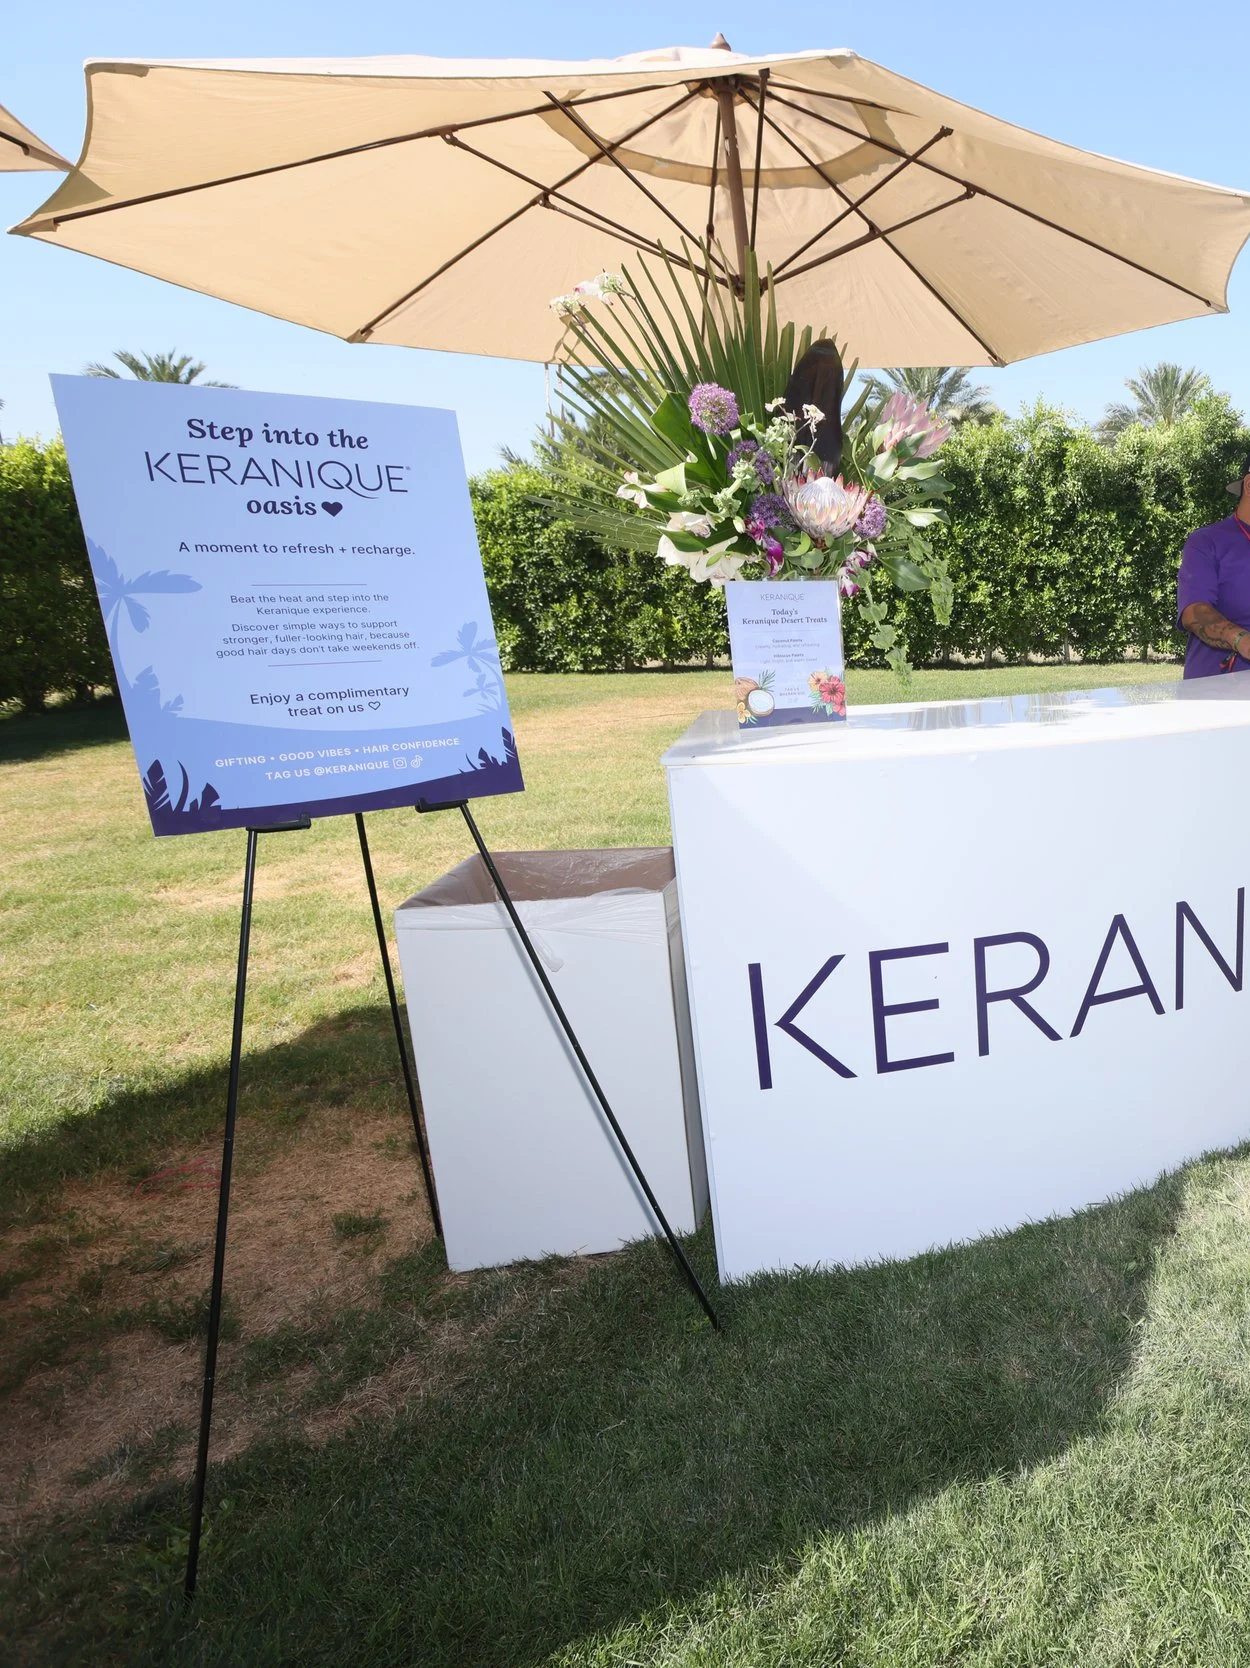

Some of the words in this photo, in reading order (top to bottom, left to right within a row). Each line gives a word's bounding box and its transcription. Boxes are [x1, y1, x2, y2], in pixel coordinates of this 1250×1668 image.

[187, 418, 253, 448] Step
[262, 423, 319, 447] into
[327, 429, 369, 449] the
[246, 495, 318, 516] oasis
[178, 542, 190, 553] A
[194, 542, 260, 554] moment
[263, 543, 278, 554] to
[282, 542, 334, 555] refresh
[351, 543, 416, 557] recharge.
[230, 595, 256, 604] Beat
[258, 595, 276, 604] the
[279, 594, 303, 603] heat
[305, 594, 325, 603] and
[328, 594, 350, 604] step
[352, 594, 371, 602] into
[373, 593, 389, 602] the
[760, 593, 805, 602] KERANIQUE
[256, 606, 310, 616] Keranique
[313, 605, 371, 616] experience.
[771, 608, 798, 616] Today's
[232, 622, 279, 632] Discover
[282, 622, 316, 632] simple
[319, 621, 346, 631] ways
[348, 621, 359, 629] to
[361, 620, 398, 630] support
[742, 618, 779, 626] Keranique
[781, 617, 803, 625] Desert
[806, 616, 828, 624] Treats
[222, 635, 273, 646] stronger,
[275, 633, 343, 644] fuller-looking
[346, 632, 368, 641] hair,
[369, 631, 410, 640] because
[216, 648, 244, 659] good
[248, 647, 268, 656] hair
[271, 646, 297, 656] days
[299, 645, 325, 654] don't
[328, 644, 350, 653] take
[352, 642, 401, 652] weekends
[404, 641, 420, 650] off.
[250, 692, 291, 706] Enjoy
[296, 693, 304, 702] a
[308, 686, 410, 701] complimentary
[288, 705, 322, 717] treat
[327, 705, 344, 715] on
[348, 703, 365, 713] us
[215, 755, 266, 768] GIFTING
[279, 751, 314, 763] GOOD
[317, 747, 352, 759] VIBES
[362, 744, 389, 755] HAIR
[392, 737, 461, 751] CONFIDENCE
[265, 770, 291, 781] TAG
[294, 768, 311, 778] US
[314, 760, 390, 776] @KERANIQUE
